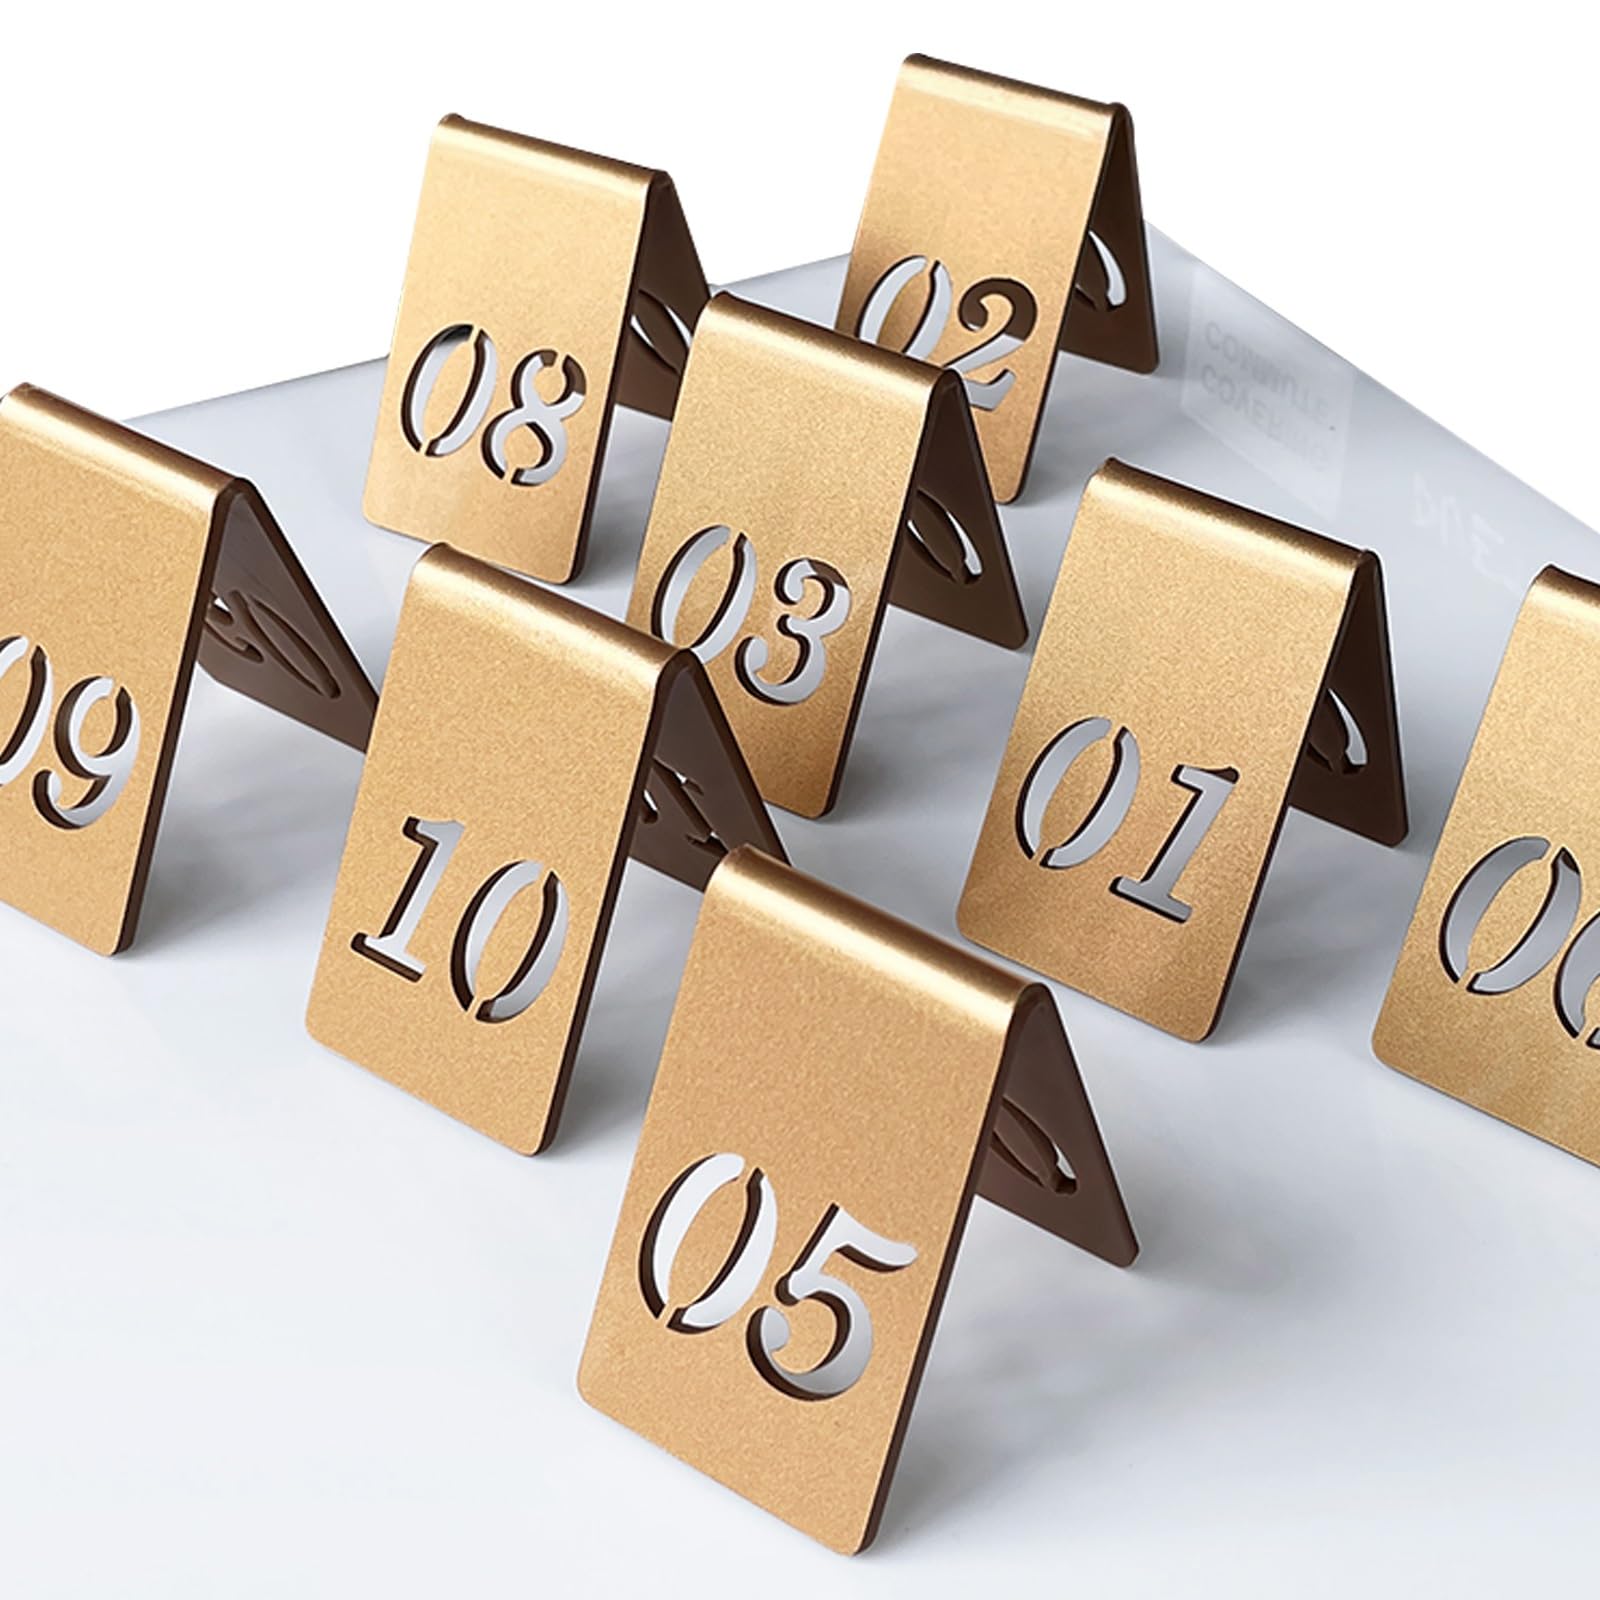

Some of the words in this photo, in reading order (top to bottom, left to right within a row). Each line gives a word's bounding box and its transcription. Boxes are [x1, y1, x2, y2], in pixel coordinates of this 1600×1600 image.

[400, 323, 587, 486] 08
[855, 255, 1038, 411] 02
[651, 524, 851, 705] 03
[1014, 716, 1240, 924] 01
[350, 816, 570, 1024] 10
[638, 1152, 918, 1402] 05
